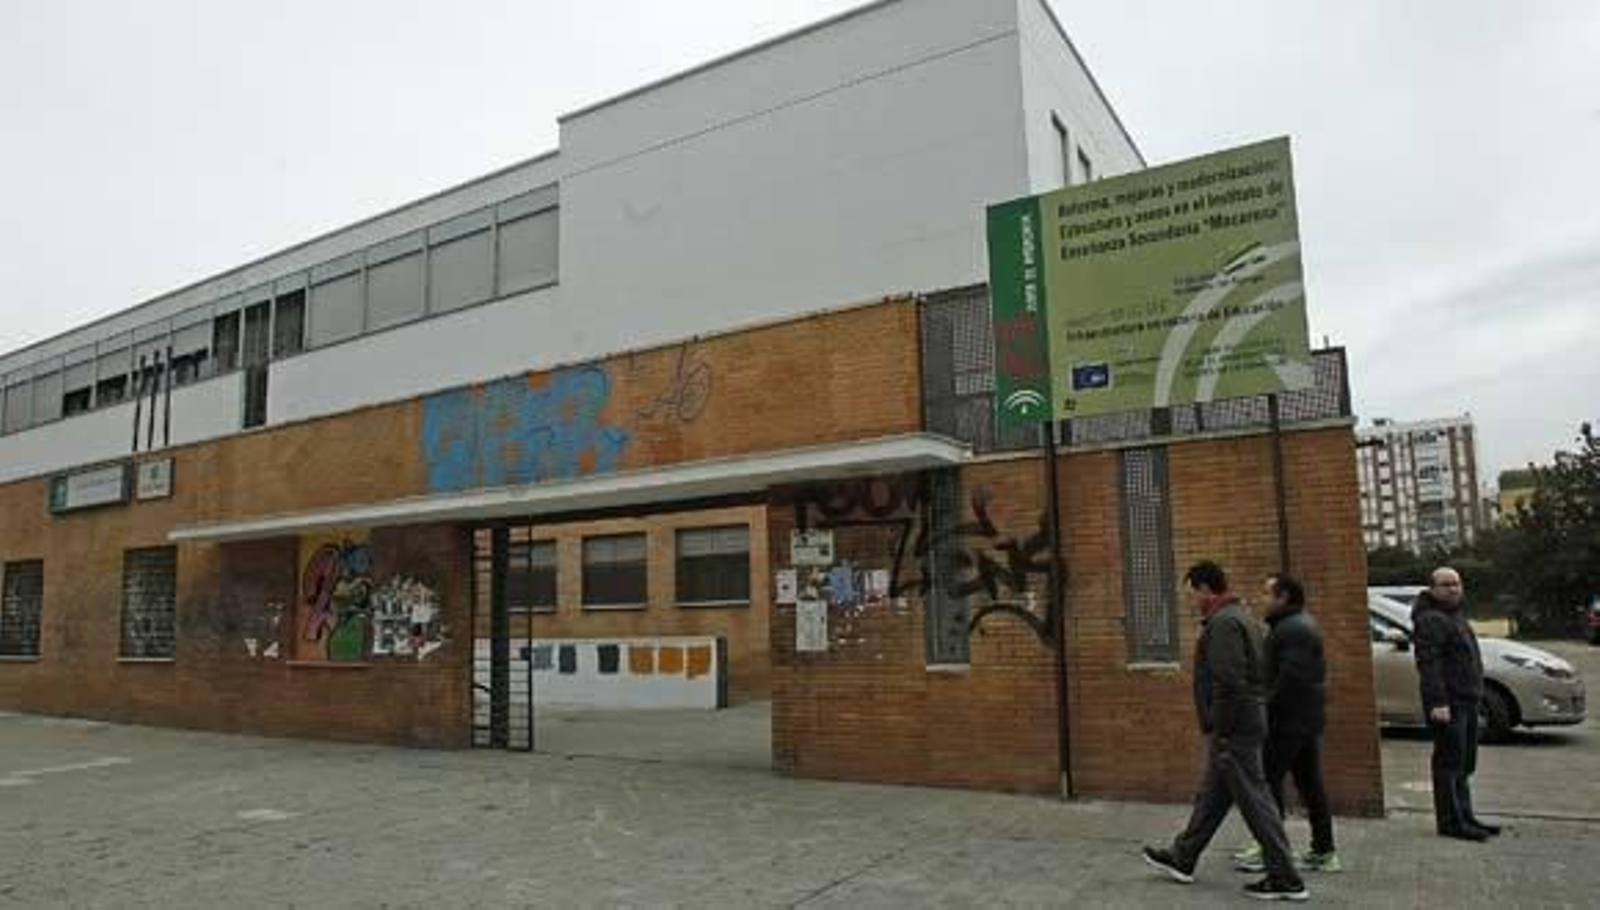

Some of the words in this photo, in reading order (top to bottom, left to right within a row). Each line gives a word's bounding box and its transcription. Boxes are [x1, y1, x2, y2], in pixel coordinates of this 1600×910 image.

[1115, 184, 1164, 206] mejoras
[1166, 183, 1174, 198] y
[1124, 214, 1132, 228] y
[1173, 200, 1189, 216] en
[1191, 193, 1205, 212] el
[1266, 176, 1285, 196] de
[1127, 220, 1200, 247] Secundaria
